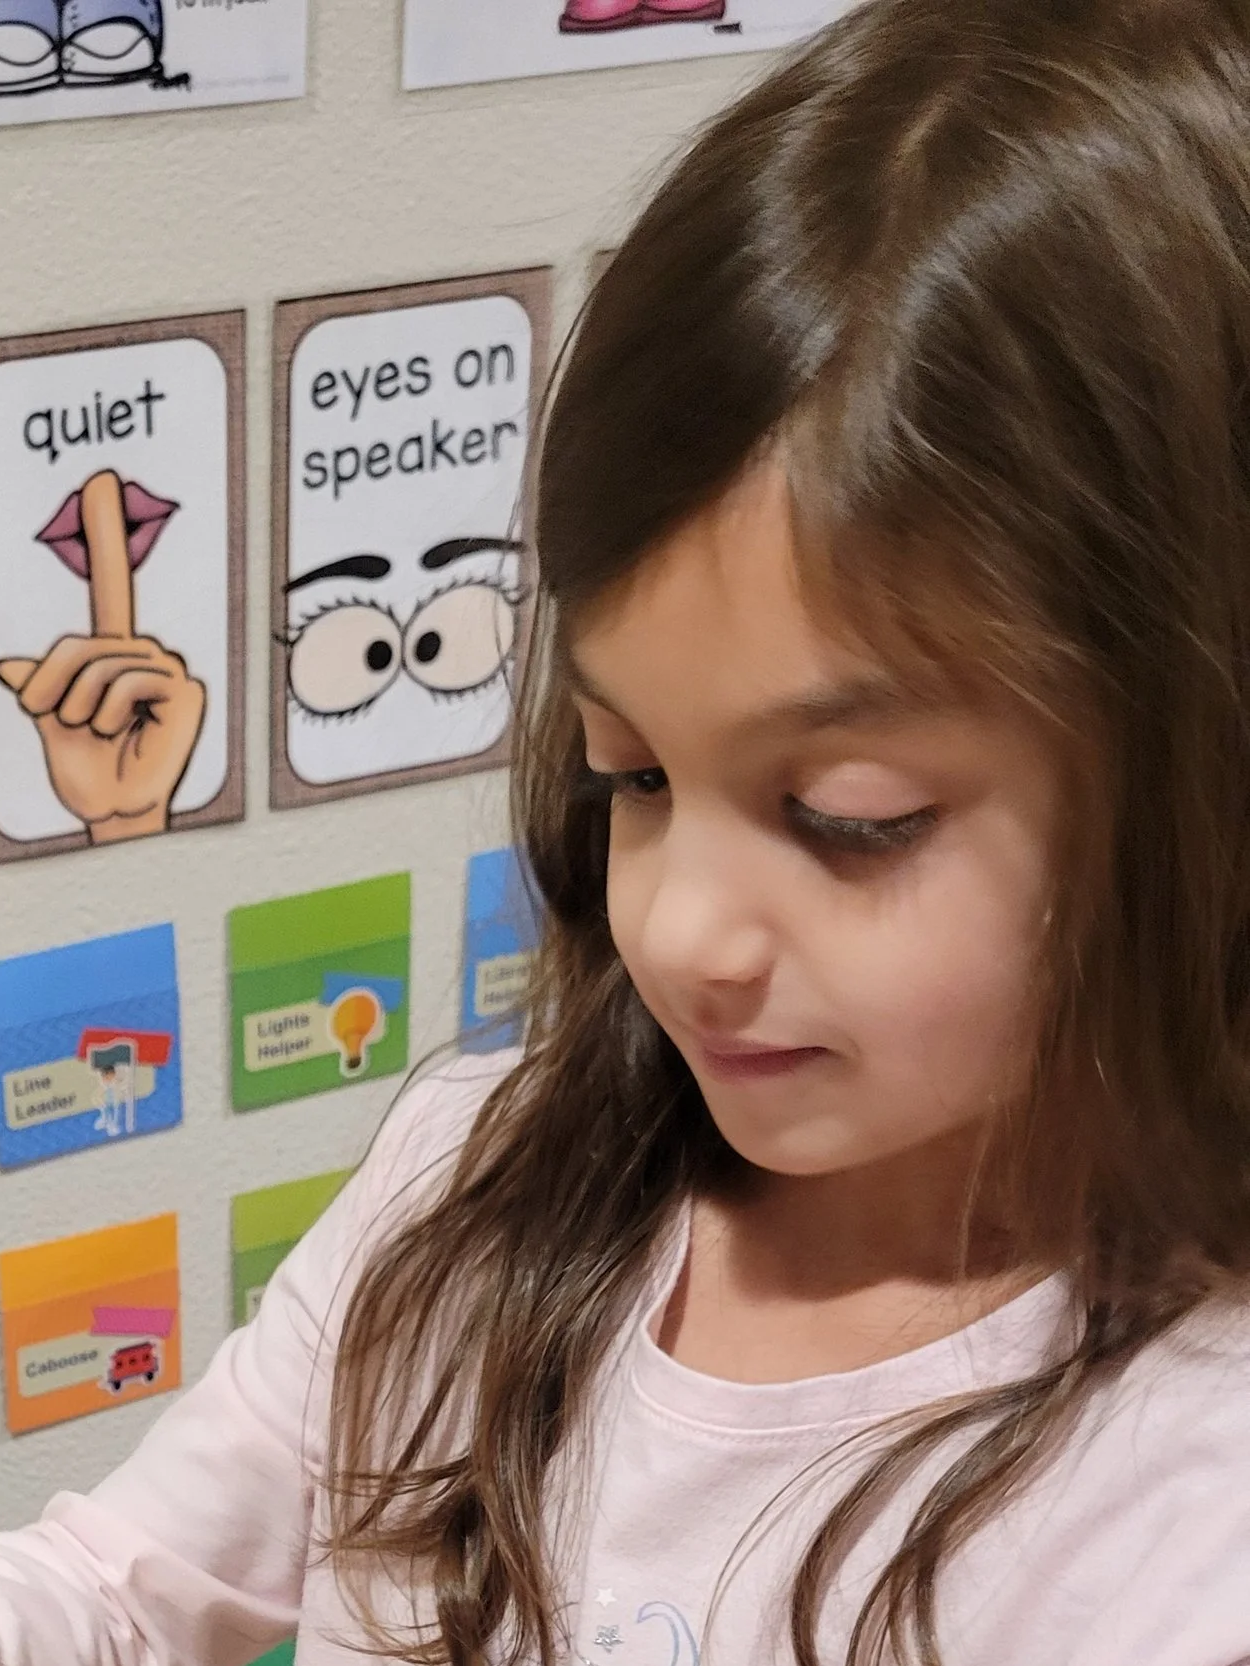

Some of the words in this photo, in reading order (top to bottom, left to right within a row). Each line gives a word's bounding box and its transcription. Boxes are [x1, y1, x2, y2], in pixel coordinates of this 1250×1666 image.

[311, 355, 433, 421] eyes
[454, 341, 516, 388] on
[23, 378, 167, 464] quiet
[302, 418, 519, 502] speaker
[257, 1012, 310, 1037] Lights
[258, 1037, 312, 1061] Helper
[13, 1077, 52, 1097] Line
[15, 1092, 76, 1120] Leader
[25, 1349, 98, 1378] Caboose
